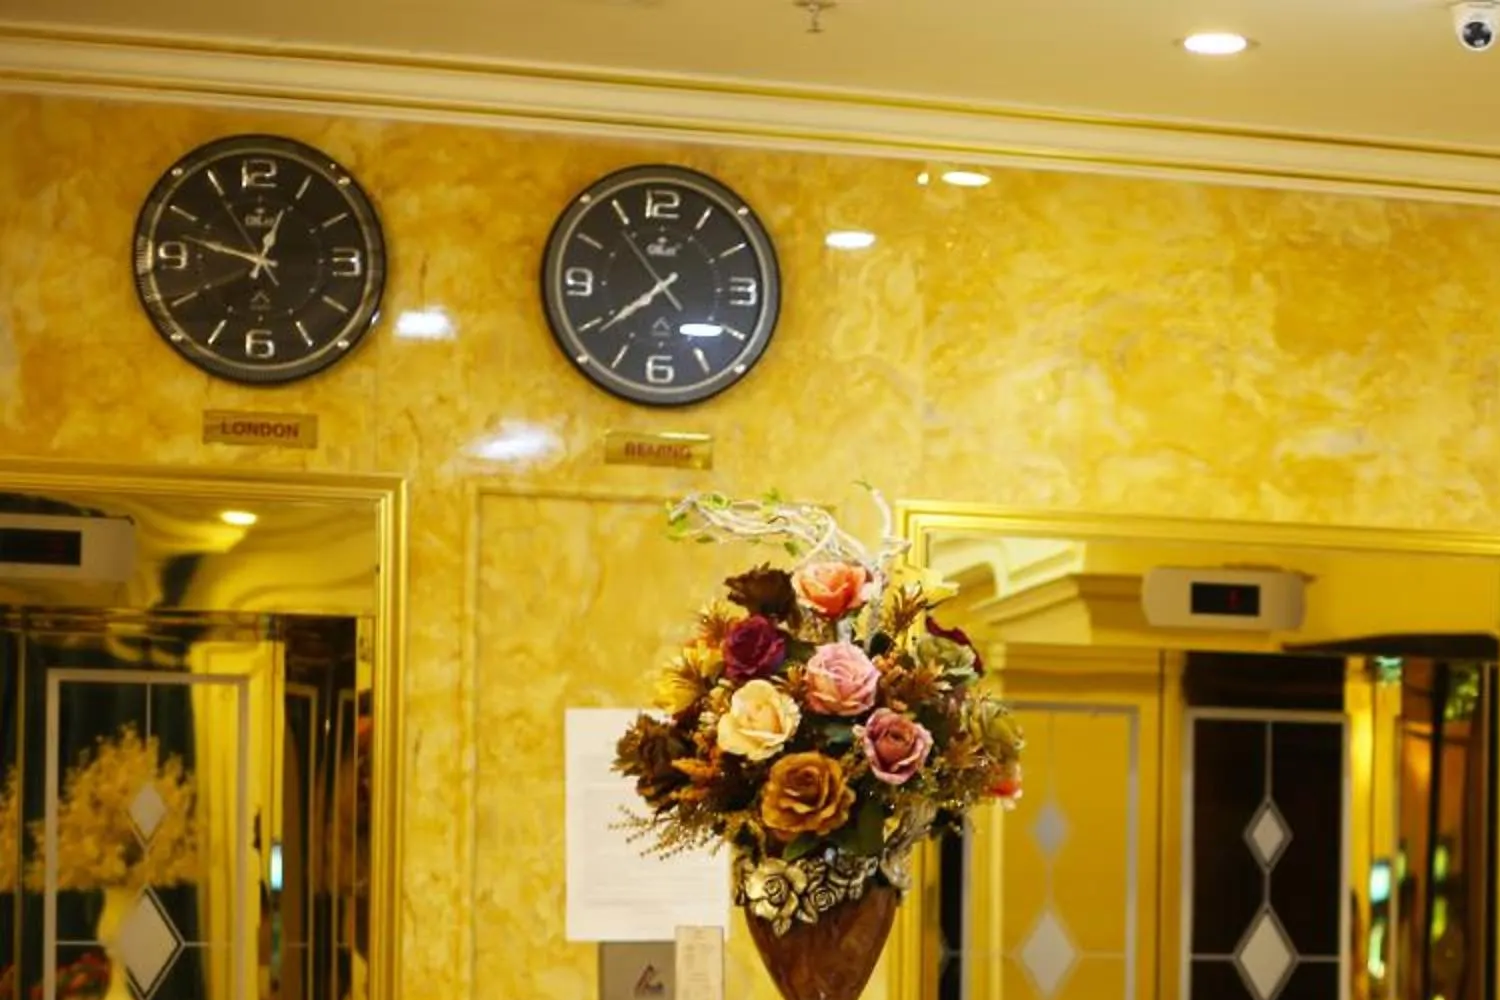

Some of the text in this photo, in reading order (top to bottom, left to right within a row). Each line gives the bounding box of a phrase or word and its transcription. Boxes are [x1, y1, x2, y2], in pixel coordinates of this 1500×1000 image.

[240, 159, 277, 189] 12
[644, 189, 681, 220] 12
[157, 240, 188, 271] 9
[331, 247, 362, 277] 3
[564, 266, 594, 297] 9
[729, 275, 758, 307] 3
[244, 328, 276, 359] 6
[645, 354, 676, 384] 6
[220, 419, 300, 439] LONDON
